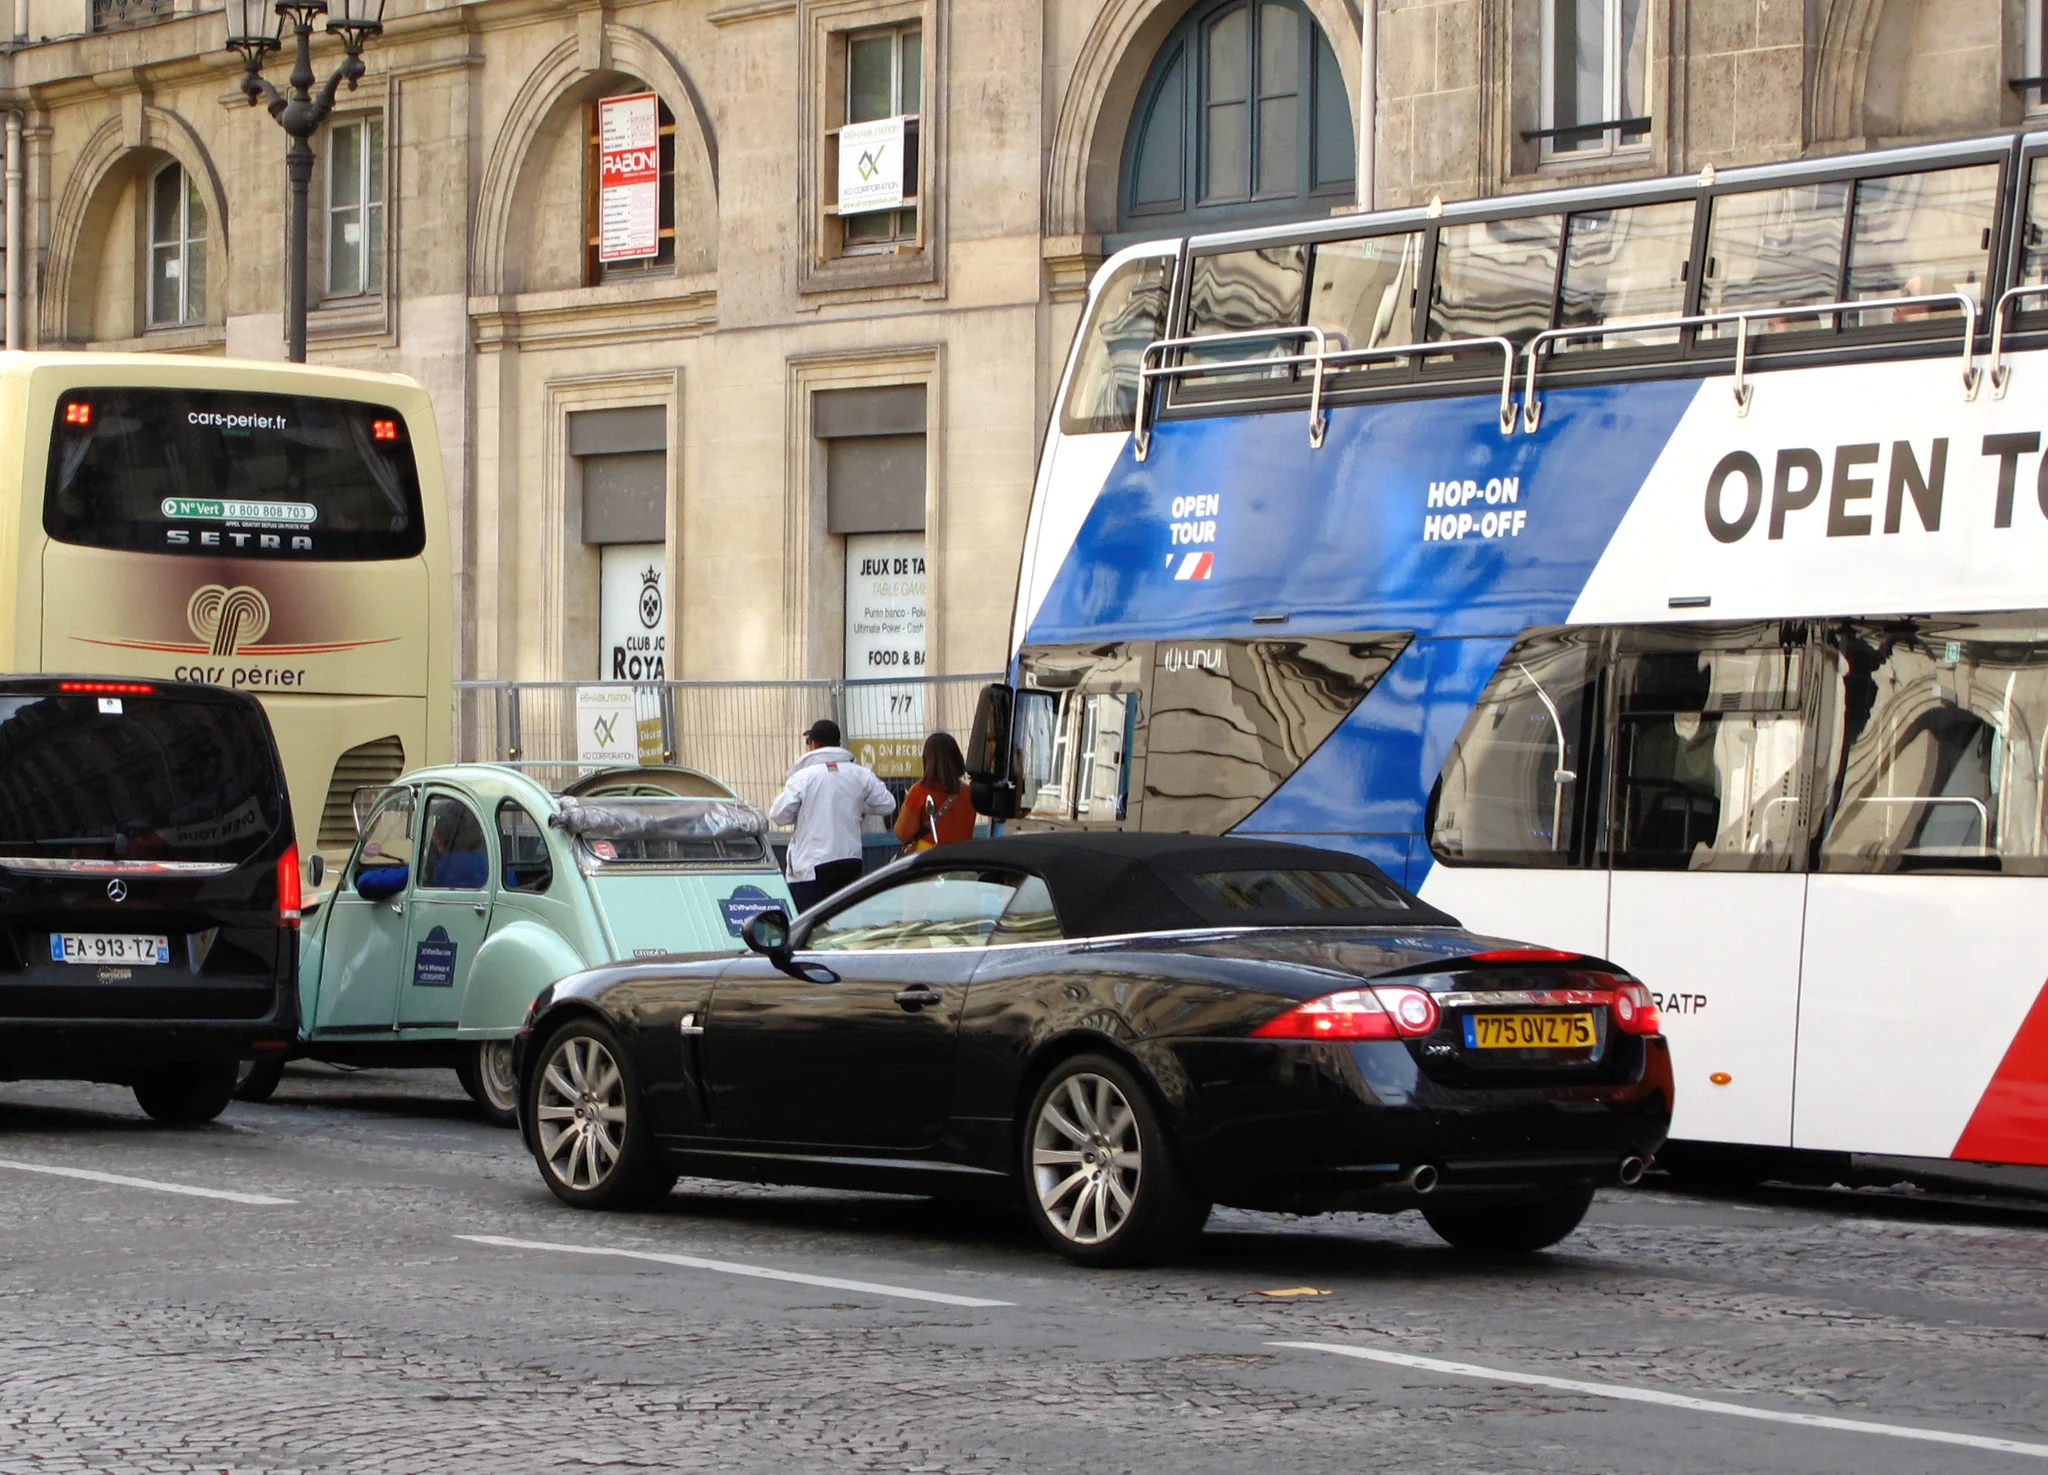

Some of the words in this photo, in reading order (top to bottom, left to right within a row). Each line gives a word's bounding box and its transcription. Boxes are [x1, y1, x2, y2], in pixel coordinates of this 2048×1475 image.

[603, 149, 656, 175] RABONI
[853, 181, 899, 195] CORPORATION
[187, 412, 287, 430] cars-perier.fr
[1427, 477, 1519, 508] HOP-ON
[1703, 437, 1949, 544] OPEN
[1981, 430, 2048, 529] T
[196, 502, 219, 515] Vert
[229, 504, 236, 515] 0
[239, 505, 260, 517] 800
[263, 505, 283, 518] 808
[286, 506, 307, 519] 703
[1171, 493, 1220, 519] OPEN
[1170, 520, 1217, 545] TOUR
[1423, 510, 1527, 541] HOP-OFF
[166, 530, 313, 551] SETRA
[860, 558, 890, 576] JEUX
[893, 558, 909, 575] DE
[872, 582, 900, 597] TABLE
[864, 607, 884, 618] Punto
[885, 607, 906, 618] banco
[853, 623, 881, 634] Ultimate
[881, 622, 901, 634] Poker
[907, 622, 924, 634] Cash
[626, 636, 651, 651] CLUB
[868, 650, 899, 666] FOOD
[902, 650, 911, 666] &
[174, 665, 225, 684] cars
[232, 664, 306, 688] périer
[890, 694, 913, 714] 7/7
[592, 751, 635, 760] CORPORATION
[879, 744, 893, 757] ON
[1652, 992, 1708, 1015] RATP
[1477, 1017, 1517, 1044] 775
[1520, 1017, 1559, 1044] QVZ
[1562, 1016, 1591, 1043] 75
